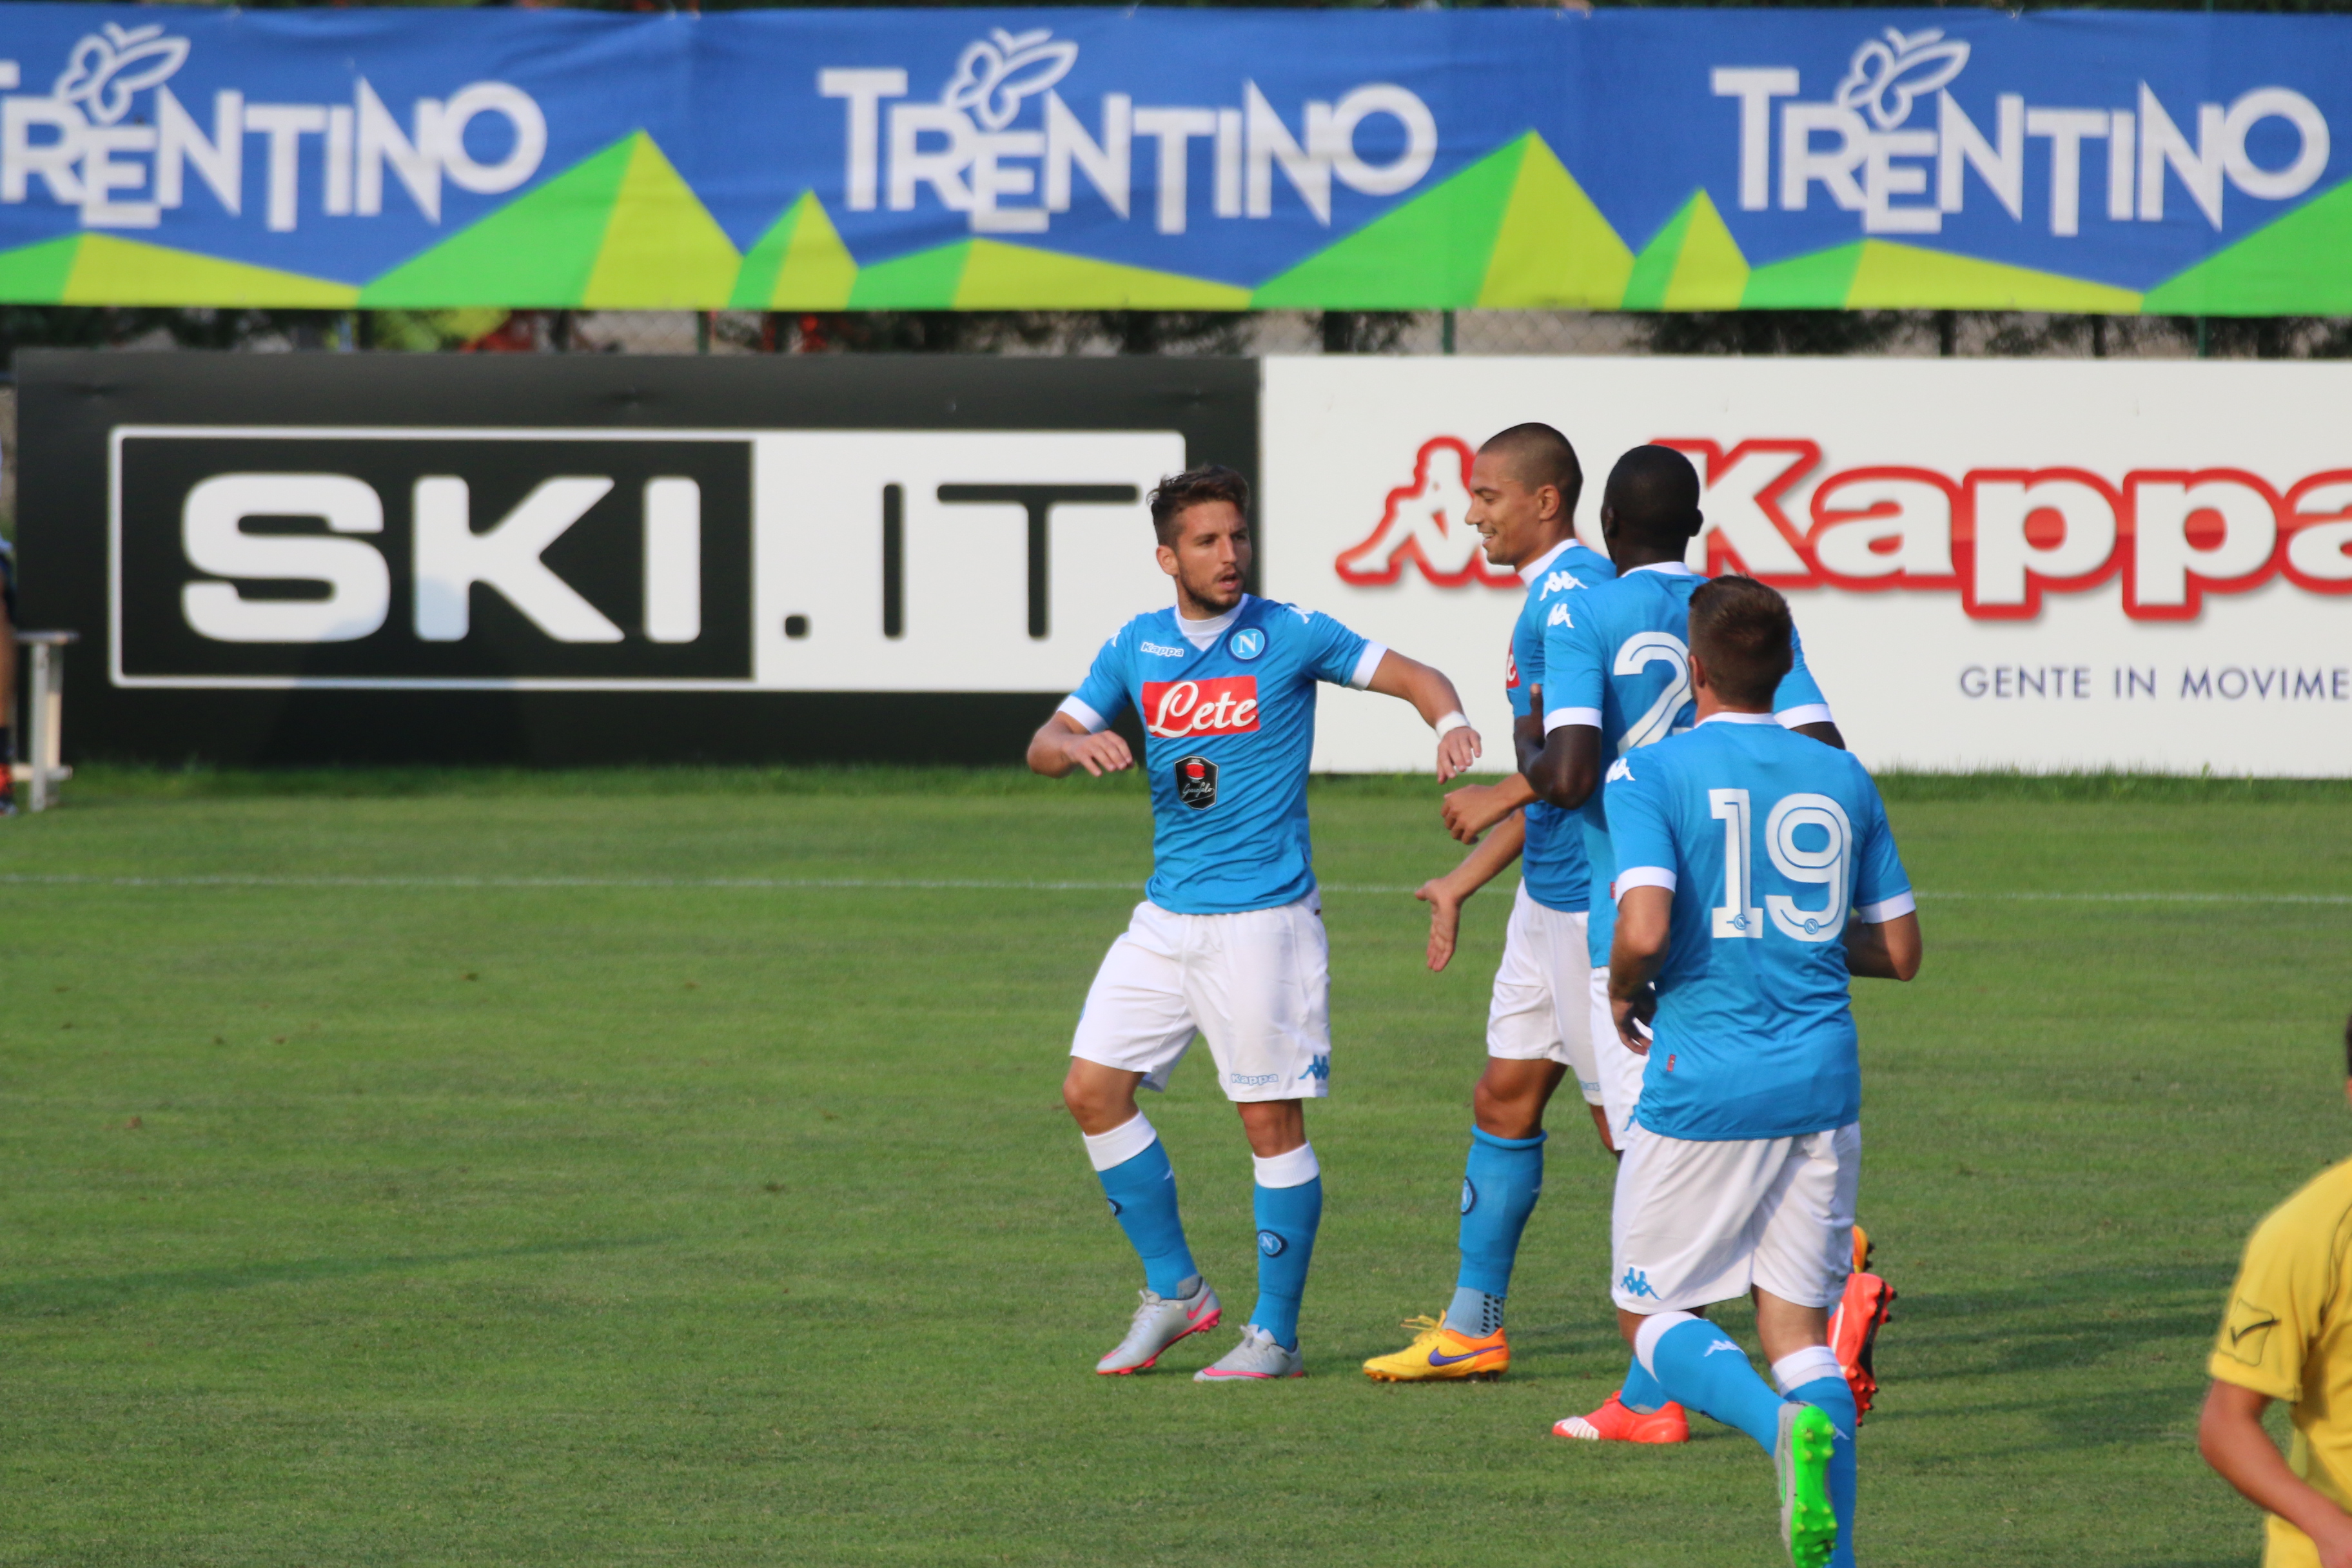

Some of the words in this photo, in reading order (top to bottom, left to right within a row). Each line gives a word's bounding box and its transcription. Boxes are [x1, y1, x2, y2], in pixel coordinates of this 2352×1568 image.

[0, 61, 547, 232] RENTINO
[818, 68, 1438, 234] TRENTINO
[1711, 67, 2330, 237] TRENTINO
[1141, 642, 1184, 658] Kappa
[1237, 633, 1257, 654] N
[1960, 665, 2091, 699] GENTE
[2115, 665, 2157, 700] IN
[2180, 665, 2351, 700] MOVIME
[1148, 681, 1257, 738] Lete
[1614, 631, 1694, 754] 2
[1709, 789, 1852, 942] 19
[1231, 1073, 1279, 1086] Kappa
